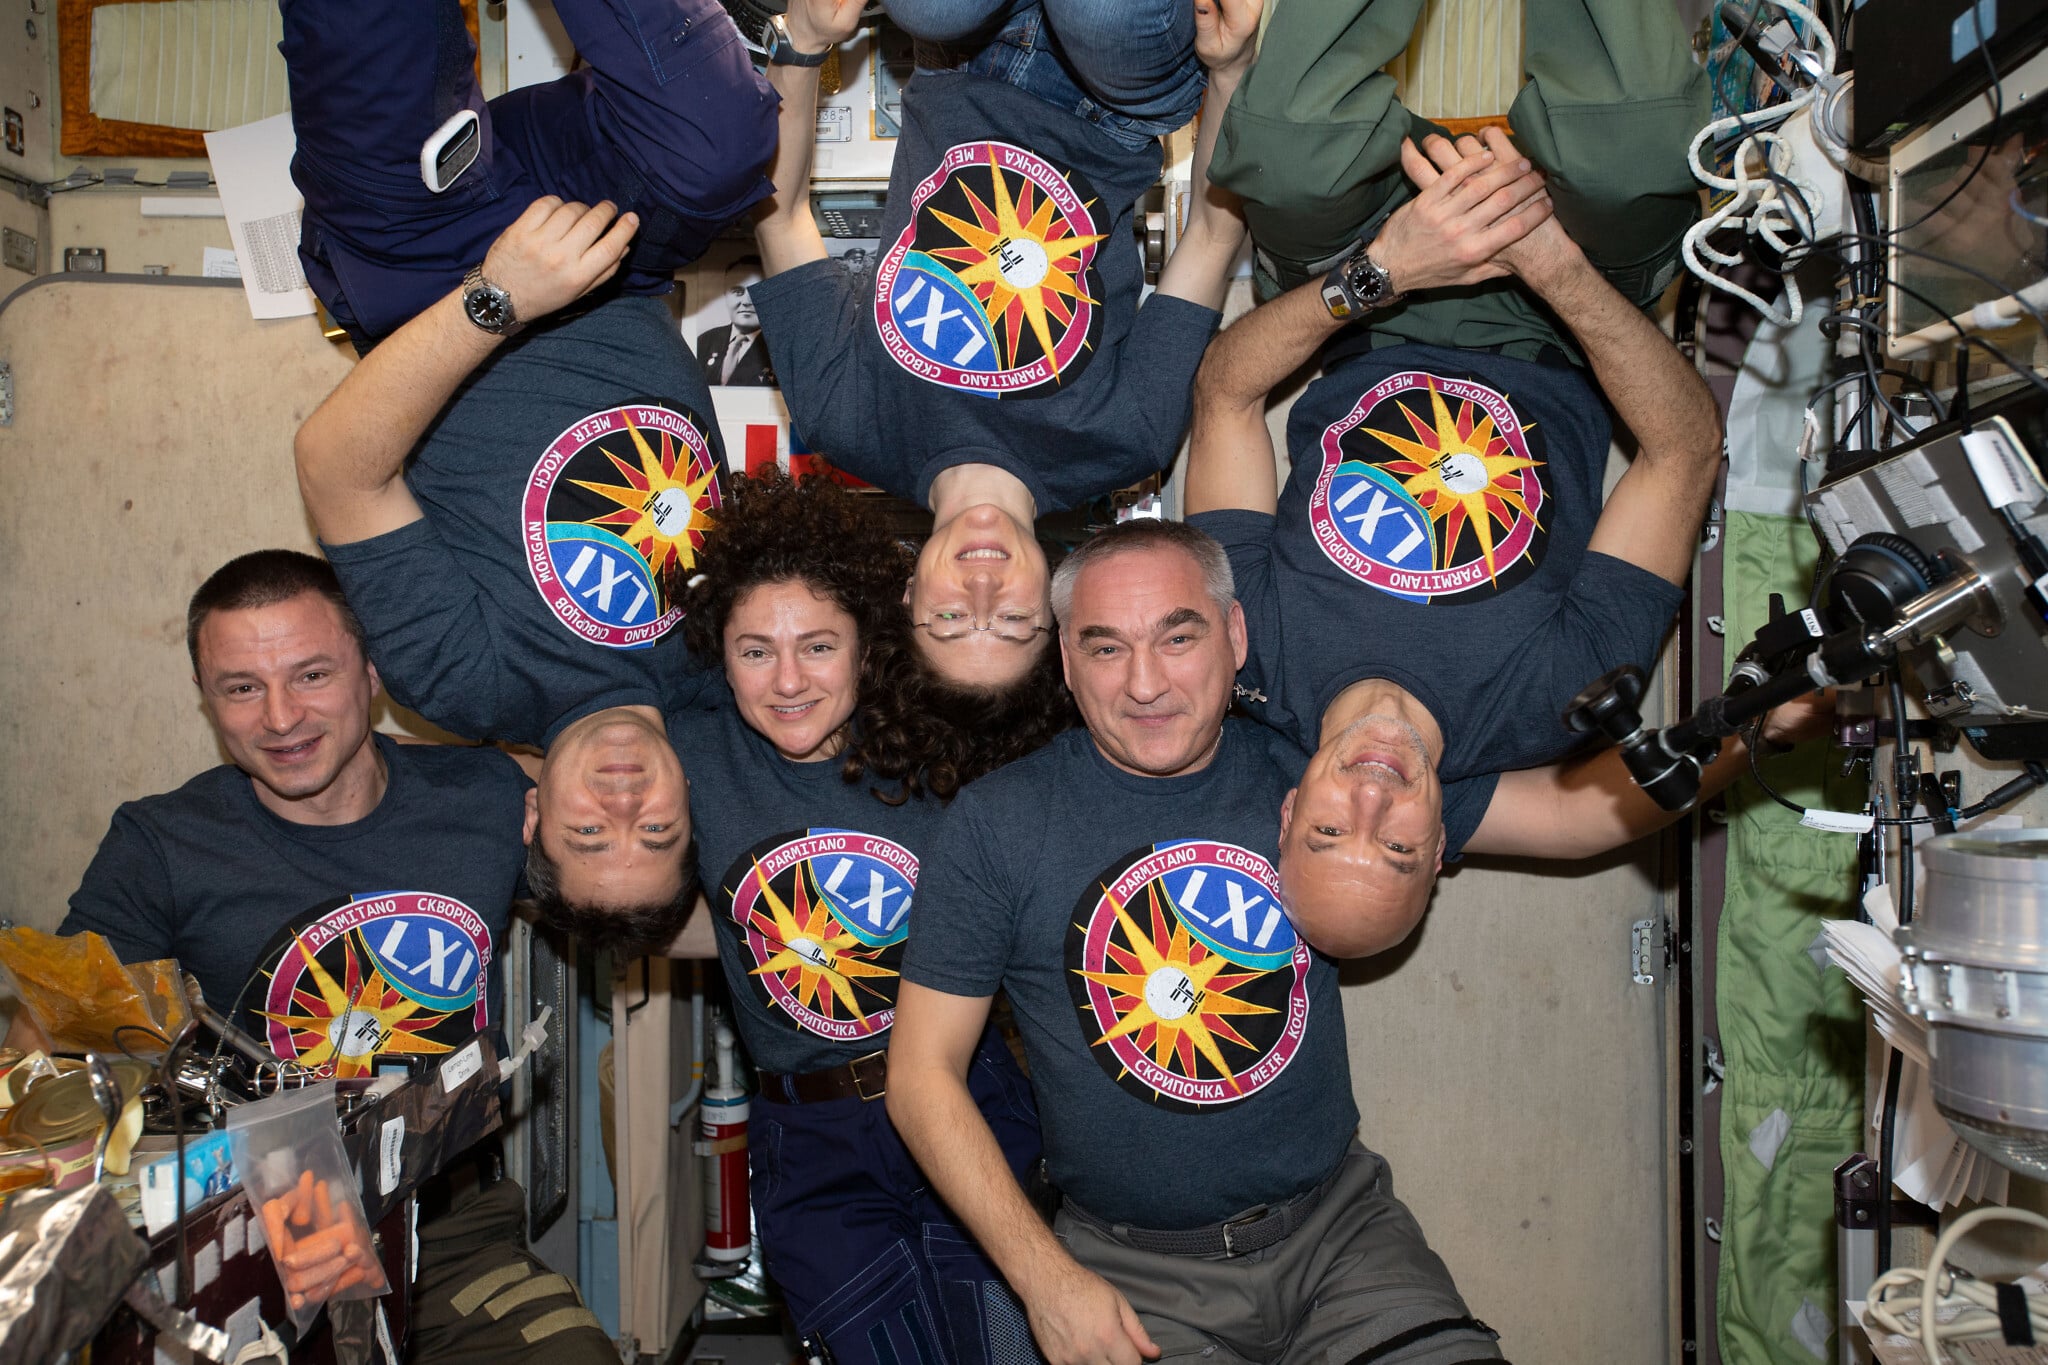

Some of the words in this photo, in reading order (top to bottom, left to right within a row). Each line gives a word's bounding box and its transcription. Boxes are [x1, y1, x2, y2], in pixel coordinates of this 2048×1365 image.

[912, 179, 937, 209] KOC
[1005, 149, 1077, 214] СКРИПОЧКА
[877, 245, 906, 303] MORGAN
[894, 275, 987, 367] LXI
[881, 320, 942, 379] СКВОРЦОВ
[959, 363, 1047, 387] PARMITANO
[1376, 375, 1414, 398] MEIR
[1329, 406, 1366, 436] KOCH
[1442, 380, 1515, 434] СКРИПОЧКА
[571, 415, 612, 444] MEIR
[637, 409, 703, 451] СКРИПОЧКА
[534, 449, 565, 490] KOCH
[1333, 479, 1426, 564] LXI
[529, 520, 554, 584] MORGAN
[1316, 518, 1372, 576] СКВОРЦОВ
[564, 545, 650, 624] LXI
[1389, 564, 1483, 590] PARMITANO
[555, 597, 610, 641] СКВОРЦОВ
[624, 606, 683, 642] ARMITANO
[766, 837, 847, 874] PARMITANO
[863, 840, 920, 883] СКВОРЦО
[1117, 847, 1197, 898] PARMITANO
[823, 857, 913, 931] LXI
[1178, 869, 1282, 949] LXI
[309, 899, 397, 946] PARMITANO
[416, 897, 483, 938] СКВОРЦОВ
[379, 919, 475, 992] LXI
[477, 945, 492, 1001] MOGAN
[781, 994, 858, 1037] СКРИПОЧКА
[1287, 996, 1305, 1041] KOCH
[1134, 1058, 1225, 1099] СКРИПОЧКА
[1249, 1051, 1286, 1087] MEIR
